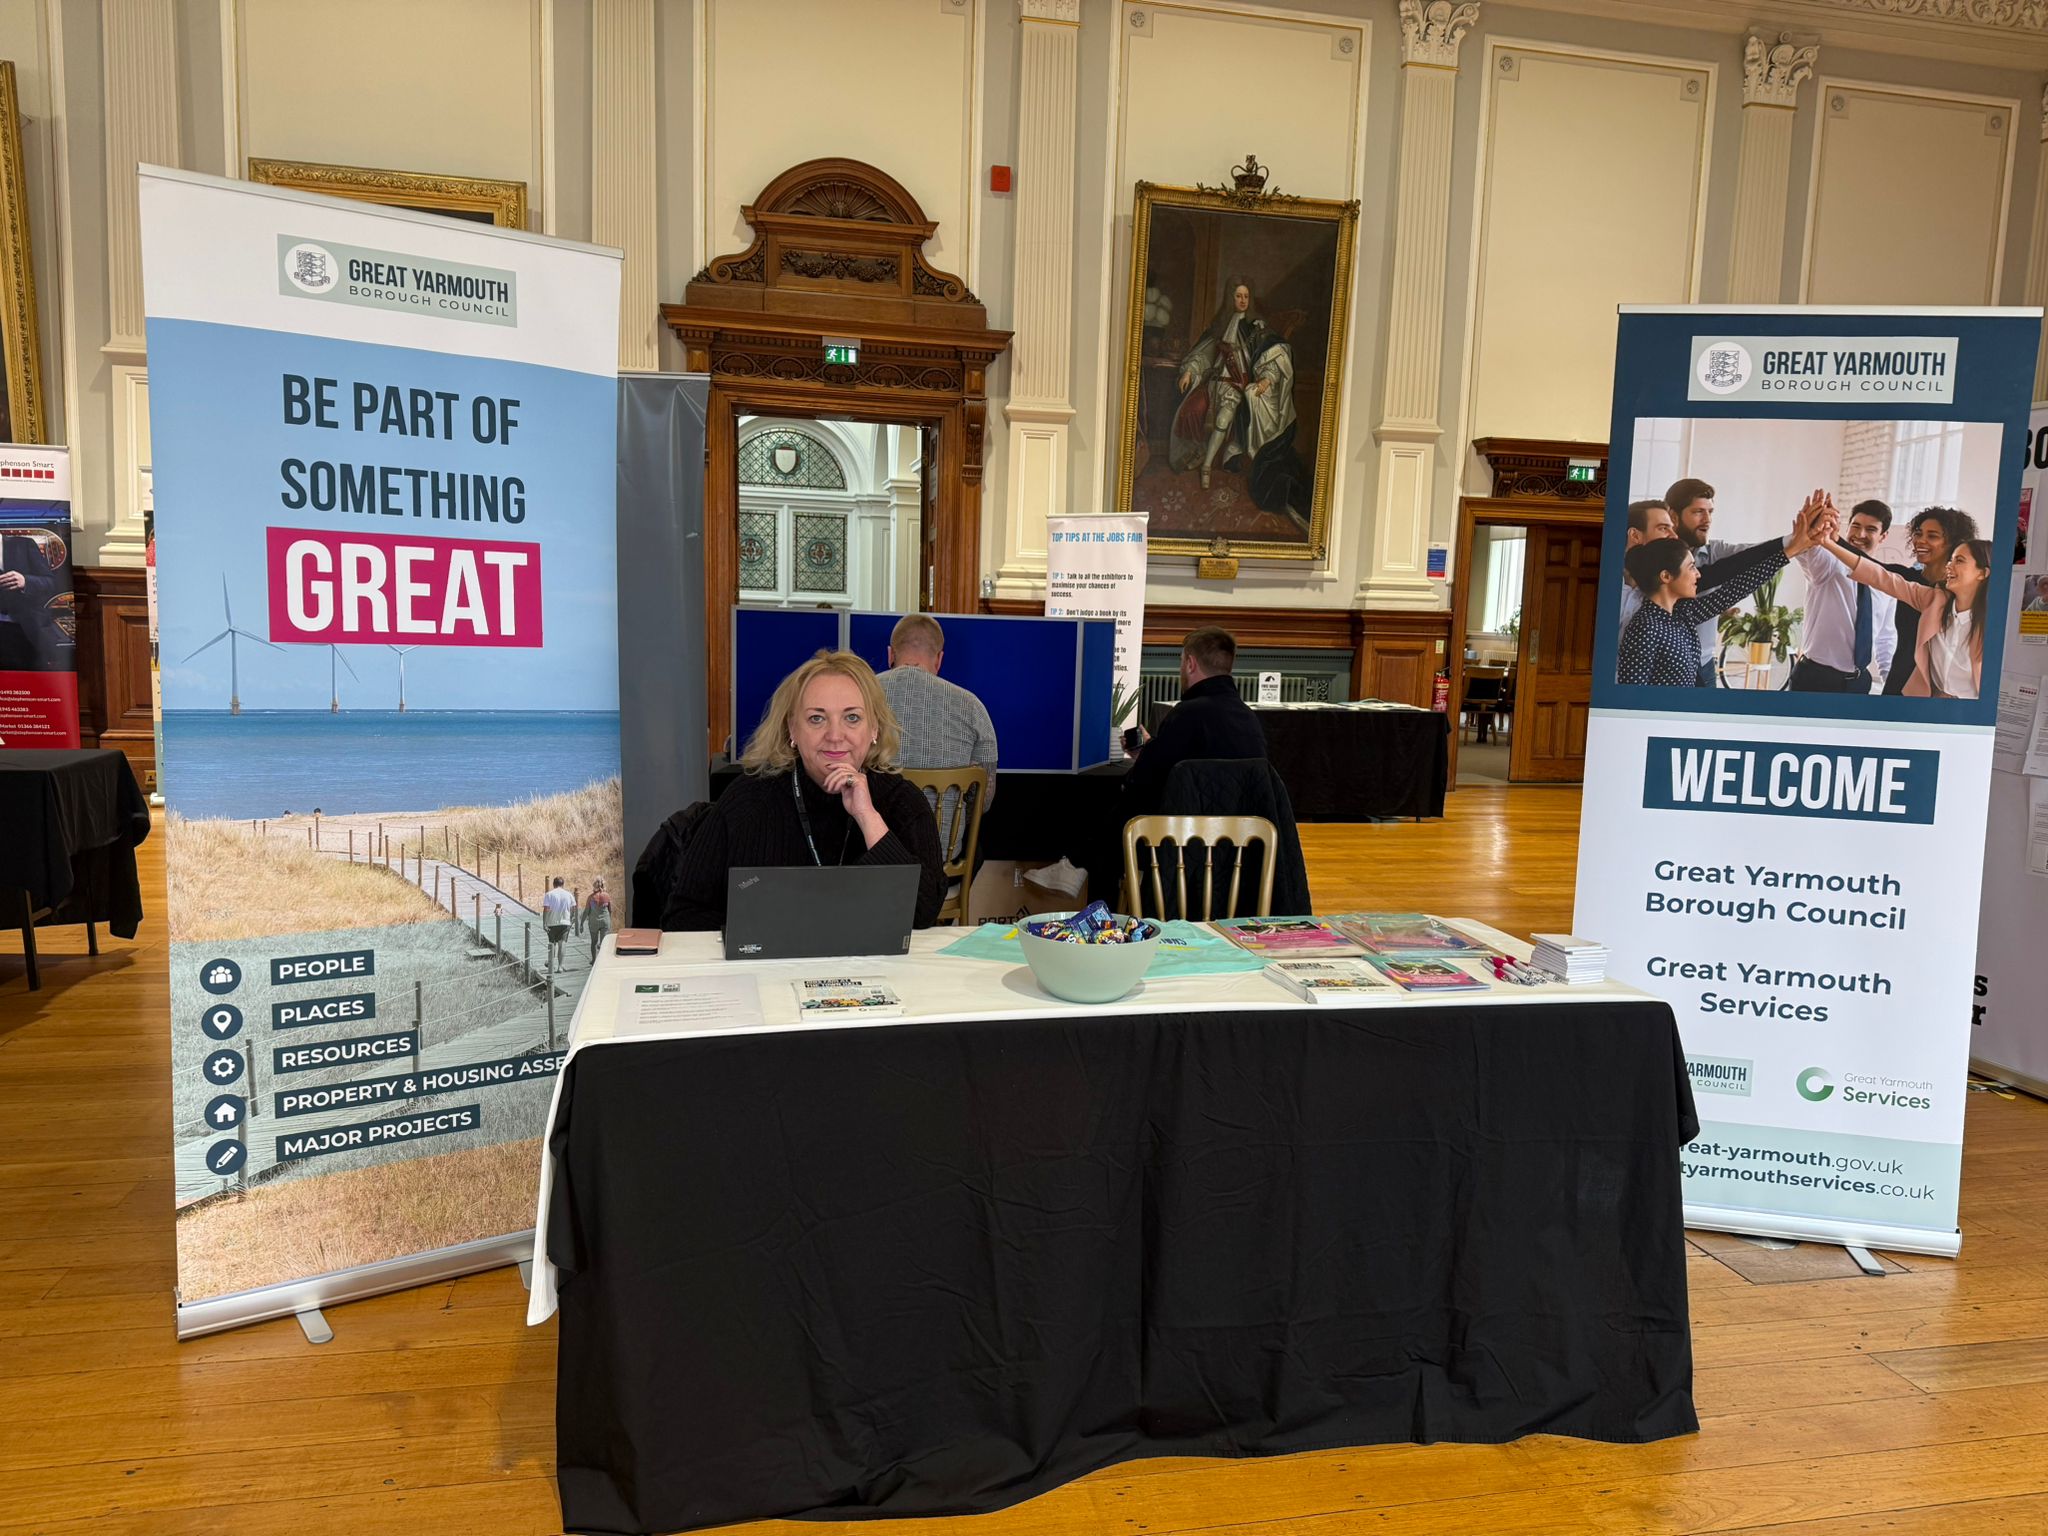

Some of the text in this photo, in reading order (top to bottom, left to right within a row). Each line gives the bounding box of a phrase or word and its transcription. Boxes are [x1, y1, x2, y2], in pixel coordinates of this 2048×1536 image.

[349, 259, 508, 303] GREAT YARMOUTH
[349, 285, 508, 317] BOROUGH COUNCIL
[1763, 351, 1946, 376] GREAT YARMOUTH
[1761, 379, 1943, 392] BOROUGH COUNCIL
[282, 373, 520, 445] BE PART OF
[280, 458, 526, 524] SOMETHING
[1052, 533, 1143, 542] TOP TIPS AT THE JOBS FAIR
[285, 539, 528, 636] GREAT
[1080, 609, 1094, 617] judge
[1670, 747, 1911, 815] WELCOME
[1654, 860, 1901, 896] Great Yarmouth
[1646, 892, 1906, 930] Borough Council
[278, 956, 365, 979] PEOPLE
[1647, 956, 1892, 995] Great Yarmouth
[280, 1000, 365, 1024] PLACES
[1699, 992, 1829, 1022] Services
[281, 1037, 411, 1068] RESOURCES
[1687, 1062, 1747, 1081] ARMOUTH
[1697, 1079, 1745, 1090] COUNCIL
[1844, 1072, 1933, 1090] Great Yarmouth
[283, 1081, 398, 1112] PROPERTY
[403, 1078, 417, 1093] &
[423, 1063, 514, 1090] HOUSING
[1842, 1086, 1931, 1109] Services
[284, 1111, 472, 1156] MAJOR PROJECTS
